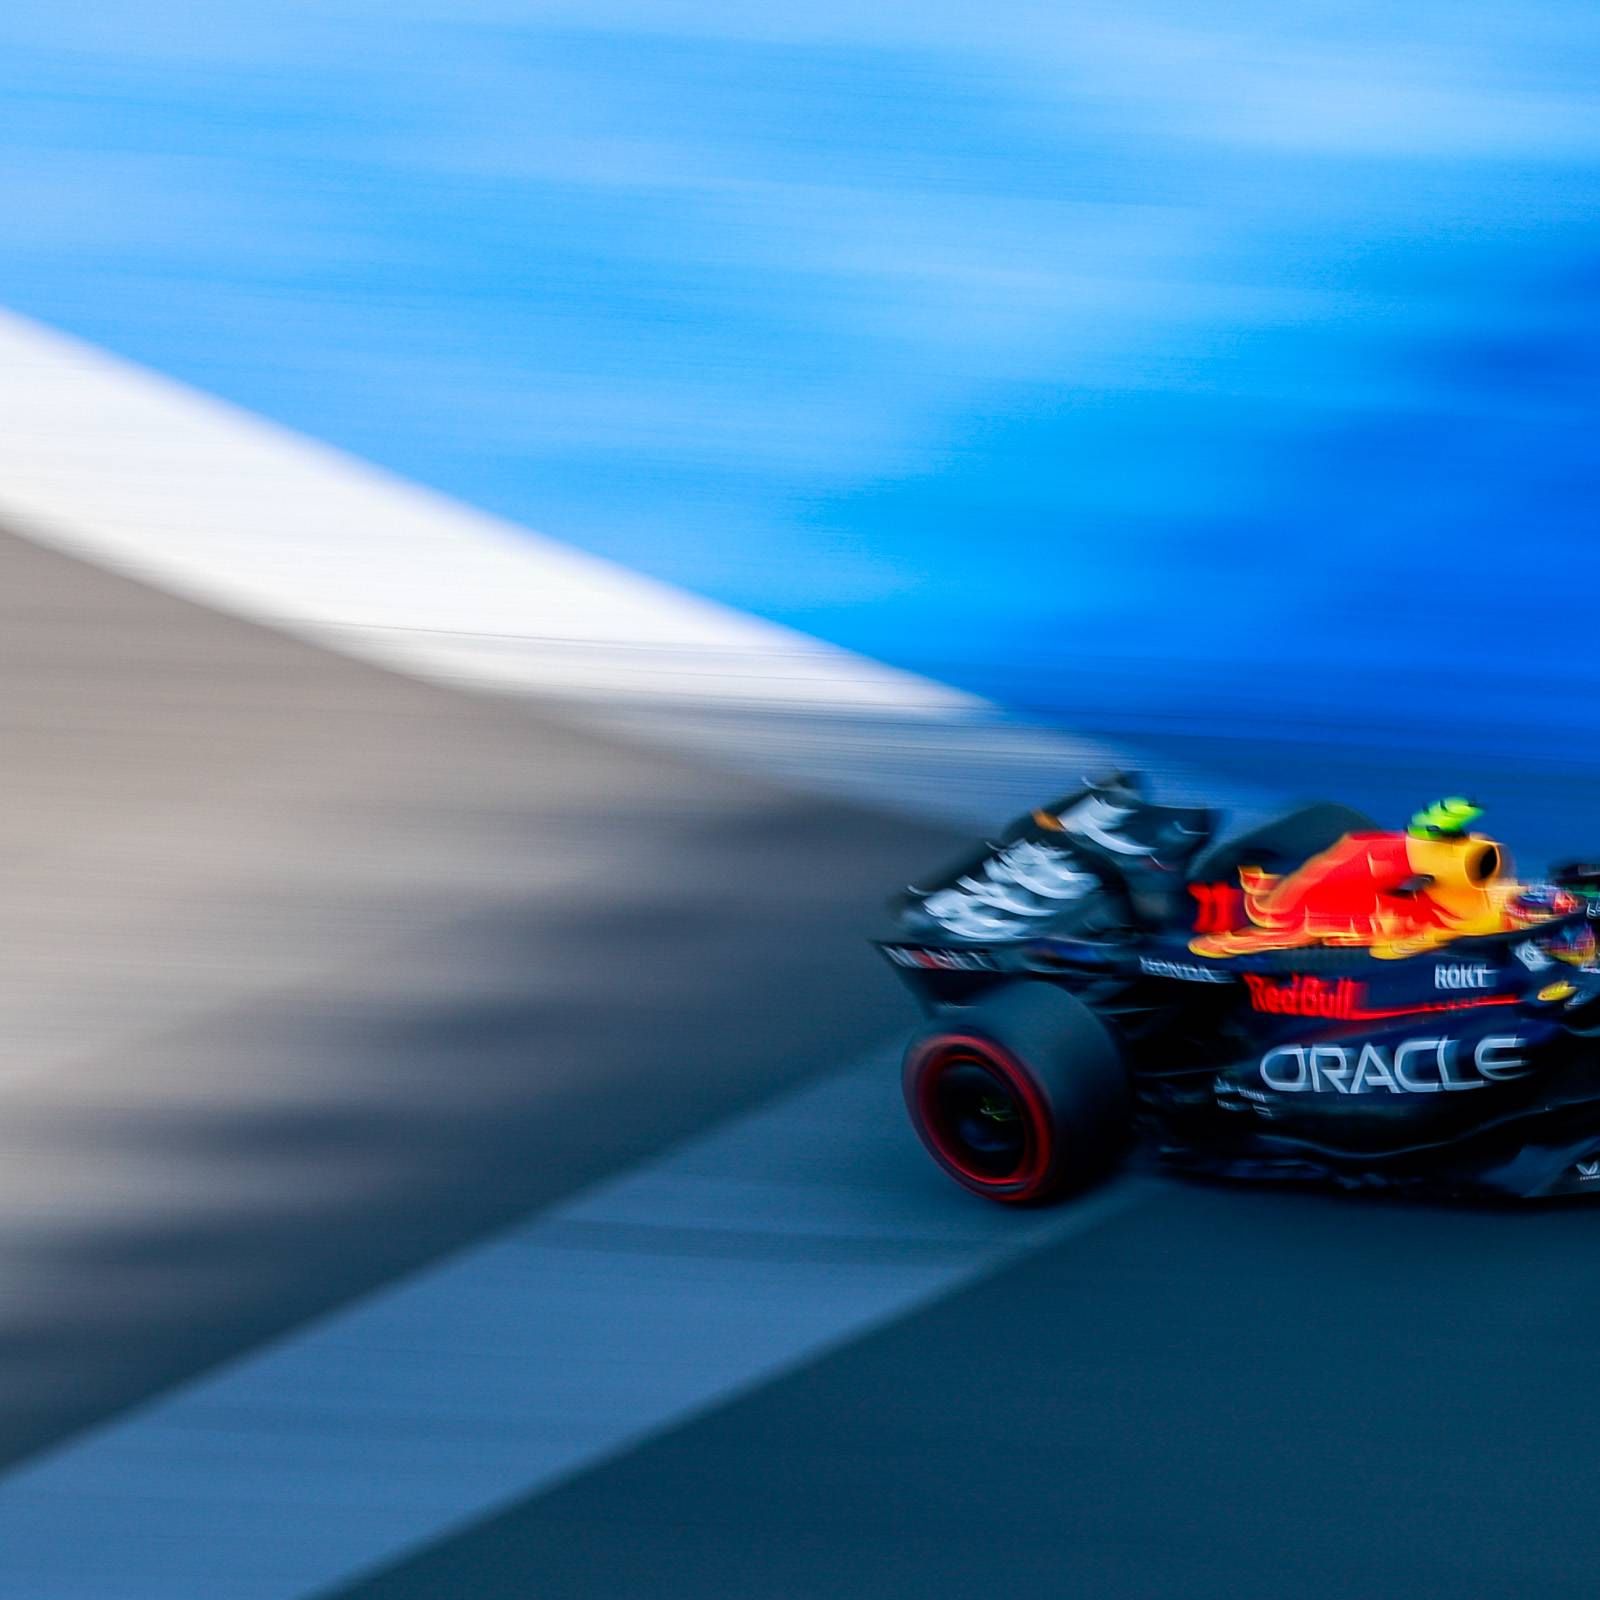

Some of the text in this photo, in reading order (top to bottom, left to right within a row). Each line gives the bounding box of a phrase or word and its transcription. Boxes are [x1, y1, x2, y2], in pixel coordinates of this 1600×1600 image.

[1246, 971, 1360, 1020] Red Bull
[1435, 965, 1488, 990] ROKT
[1260, 1034, 1533, 1094] ORACLE
